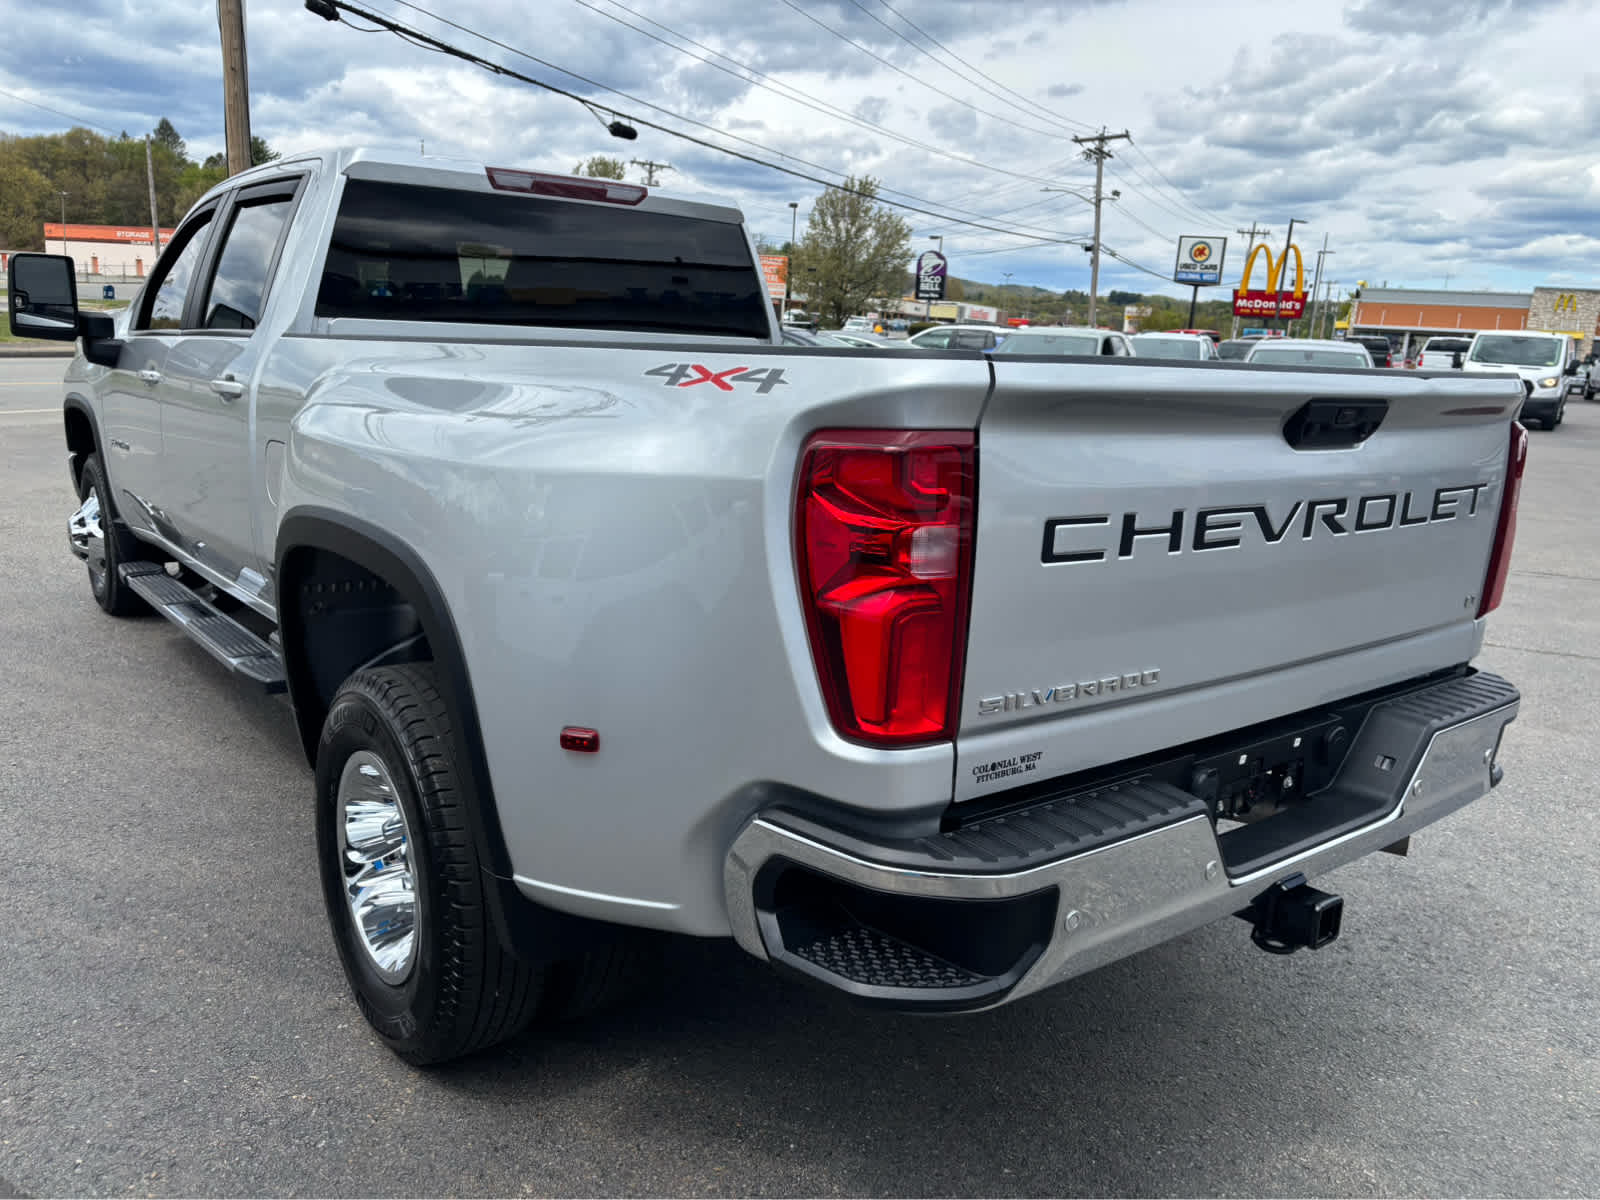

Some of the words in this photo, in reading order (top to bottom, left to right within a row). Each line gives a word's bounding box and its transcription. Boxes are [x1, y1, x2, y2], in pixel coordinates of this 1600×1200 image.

[919, 275, 942, 283] TACO
[919, 282, 941, 291] BELL
[1041, 483, 1489, 567] CHEVROLET
[979, 668, 1161, 716] SILVERADO
[972, 757, 1018, 775] COLONIAL
[1019, 751, 1043, 764] WEST
[1025, 762, 1036, 772] MA
